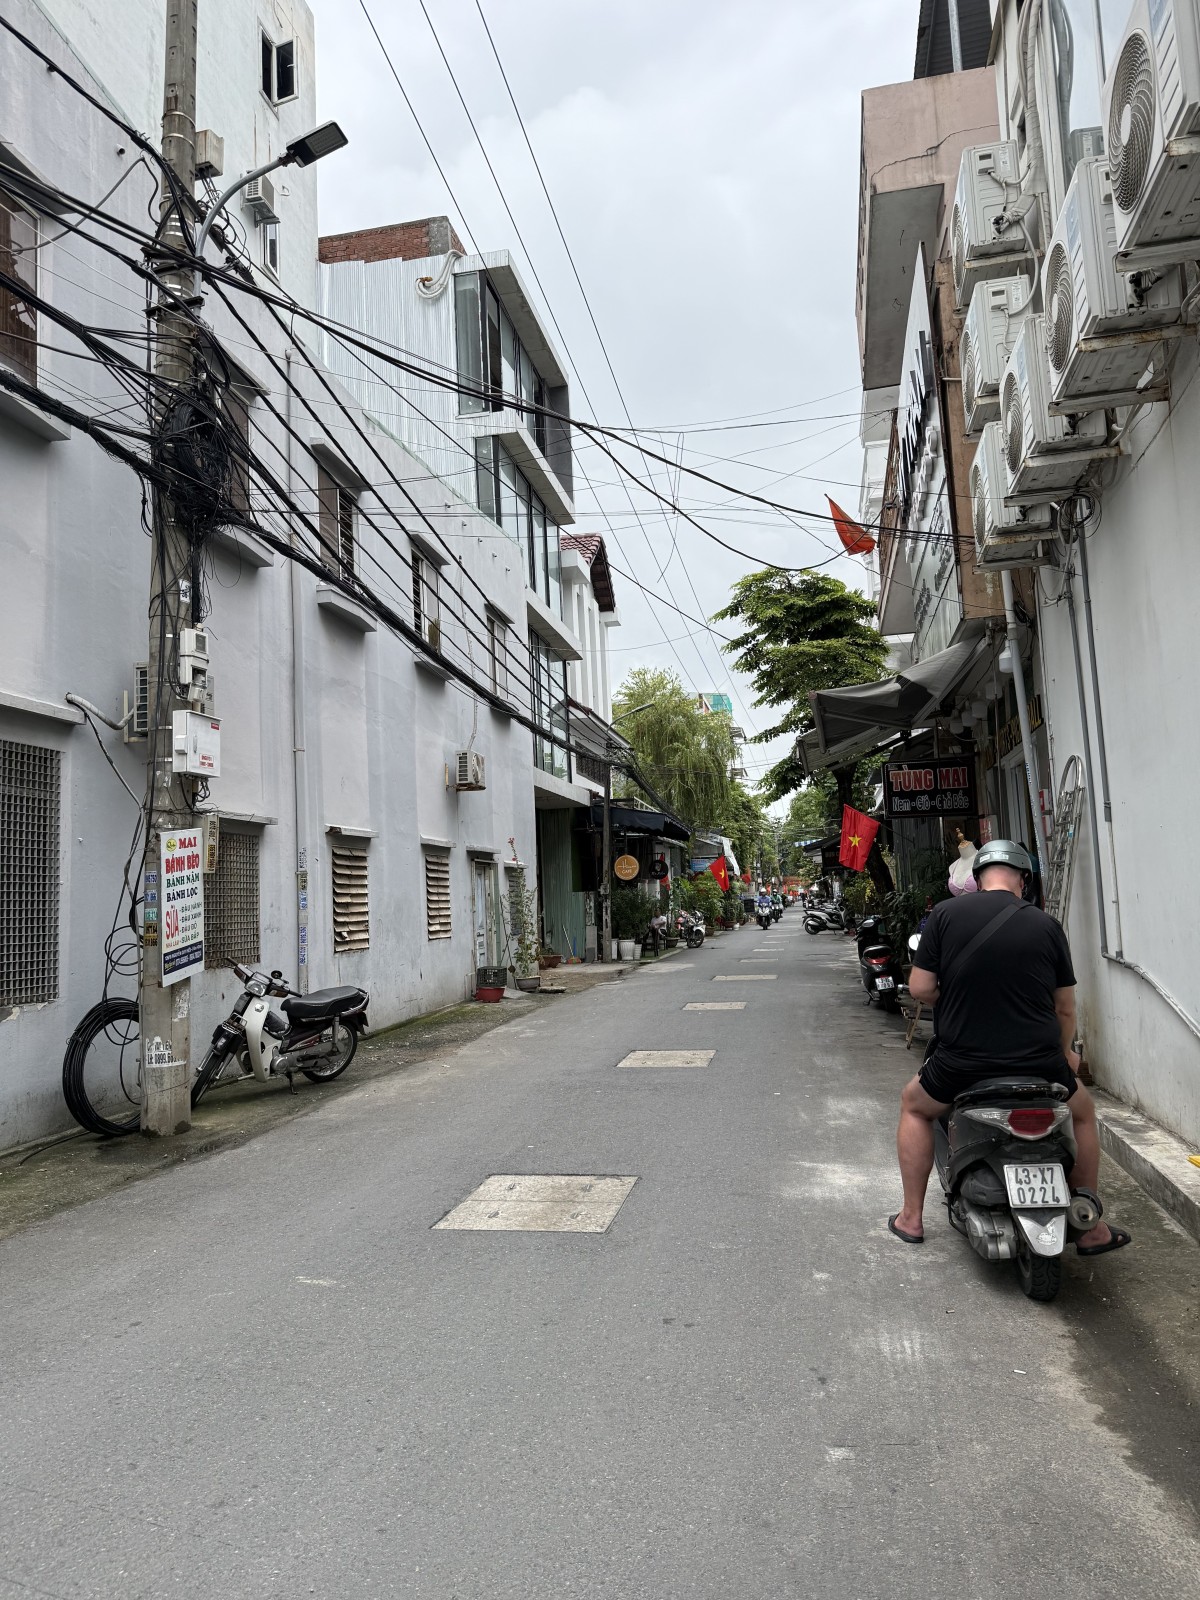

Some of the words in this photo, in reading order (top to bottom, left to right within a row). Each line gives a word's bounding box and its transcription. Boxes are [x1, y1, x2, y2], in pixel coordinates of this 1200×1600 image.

[890, 765, 934, 791] TÙNG
[937, 767, 968, 789] MAI
[178, 836, 197, 849] MAI
[165, 854, 185, 874] BÁNH
[166, 875, 185, 888] BÁNH
[166, 889, 186, 902] BÁNH
[186, 886, 198, 899] LỌC
[166, 904, 180, 940] SỮA
[1014, 1167, 1054, 1185] 43-X7
[1017, 1186, 1060, 1204] 0224
